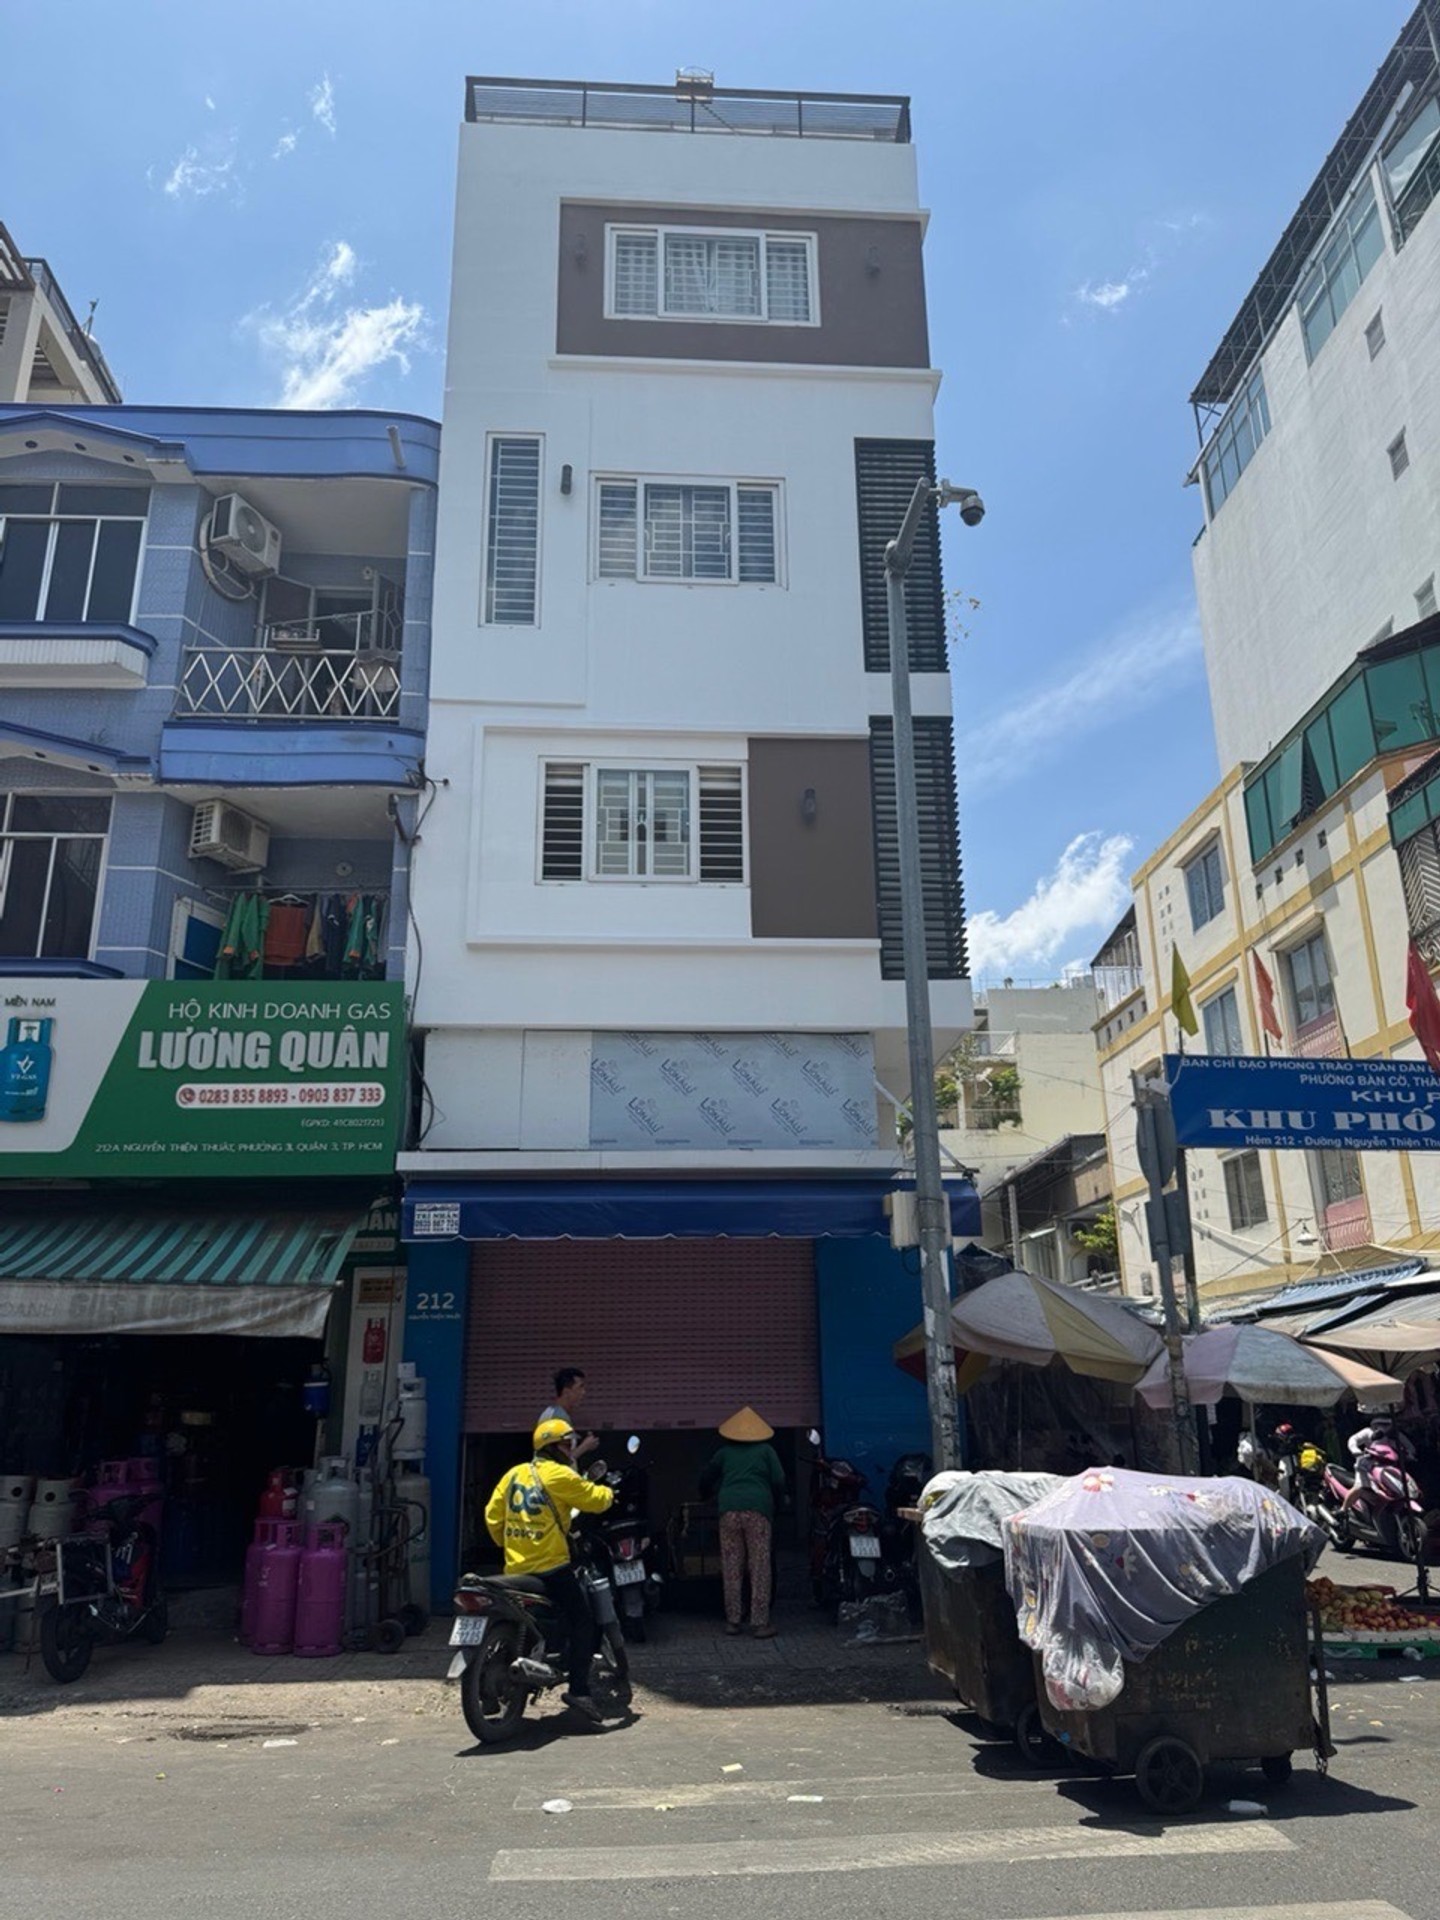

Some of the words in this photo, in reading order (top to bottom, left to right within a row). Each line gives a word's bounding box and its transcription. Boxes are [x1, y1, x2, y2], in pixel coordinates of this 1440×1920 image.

[32, 997, 56, 1007] NAM
[168, 998, 201, 1021] HỘ
[208, 1003, 258, 1019] KINH
[263, 1002, 342, 1019] DOANH
[347, 1003, 391, 1019] GAS
[138, 1026, 272, 1070] LƯƠNG
[279, 1025, 390, 1072] QUÂN
[1182, 1058, 1209, 1068] BAN
[1238, 1059, 1267, 1071] ĐẠO
[1270, 1060, 1315, 1070] PHONG
[1300, 1073, 1354, 1086] PHƯỜNG
[1357, 1074, 1386, 1087] BÀN
[1412, 1074, 1440, 1087] THÀ
[199, 1089, 229, 1104] 0283
[232, 1089, 255, 1104] 835
[258, 1088, 288, 1104] 8893
[299, 1087, 329, 1103] 0903
[333, 1087, 356, 1103] 837
[359, 1087, 381, 1102] 333
[1351, 1091, 1416, 1103] KHU
[1207, 1108, 1317, 1130] KHU
[1331, 1104, 1436, 1132] PHỐ
[95, 1143, 120, 1152] 212A
[358, 1142, 383, 1151] HCM
[1273, 1135, 1295, 1146] 212
[1304, 1135, 1342, 1148] Đường
[1344, 1136, 1387, 1148] Nguyễn
[416, 1292, 456, 1310] 212
